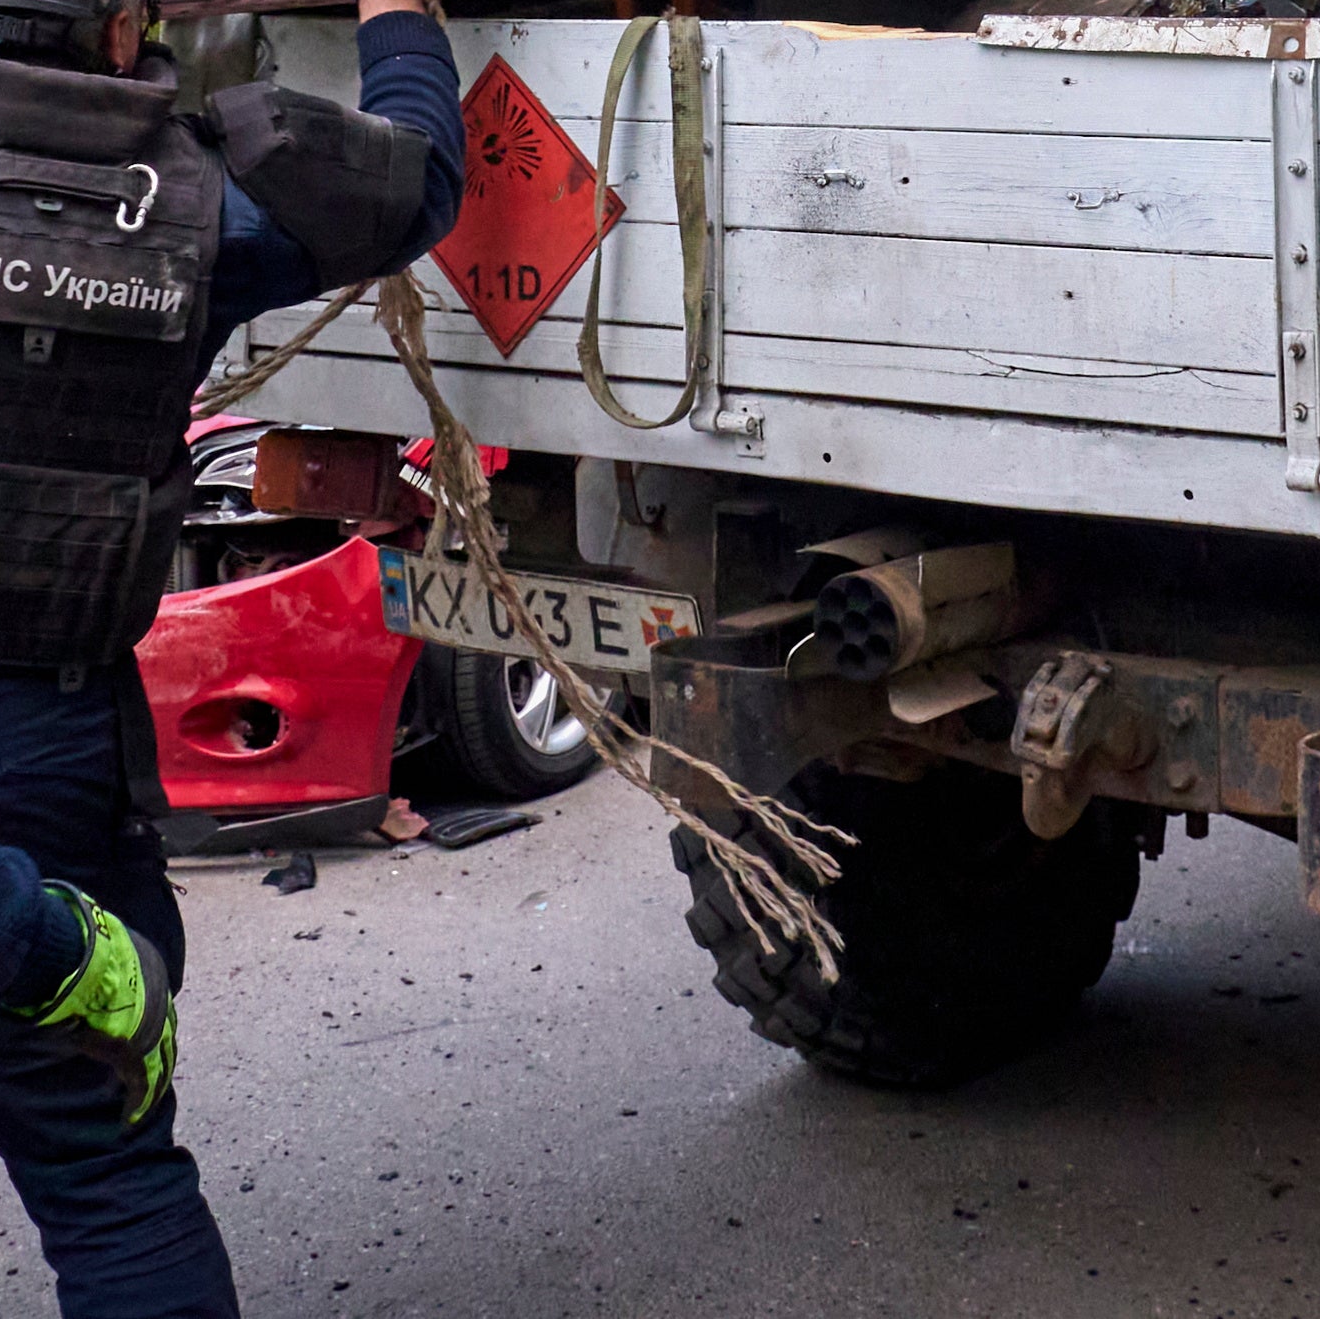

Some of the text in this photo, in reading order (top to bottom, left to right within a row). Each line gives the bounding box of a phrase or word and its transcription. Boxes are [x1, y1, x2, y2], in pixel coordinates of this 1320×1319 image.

[43, 263, 183, 314] України
[467, 264, 542, 302] 1.1D
[589, 594, 629, 657] E
